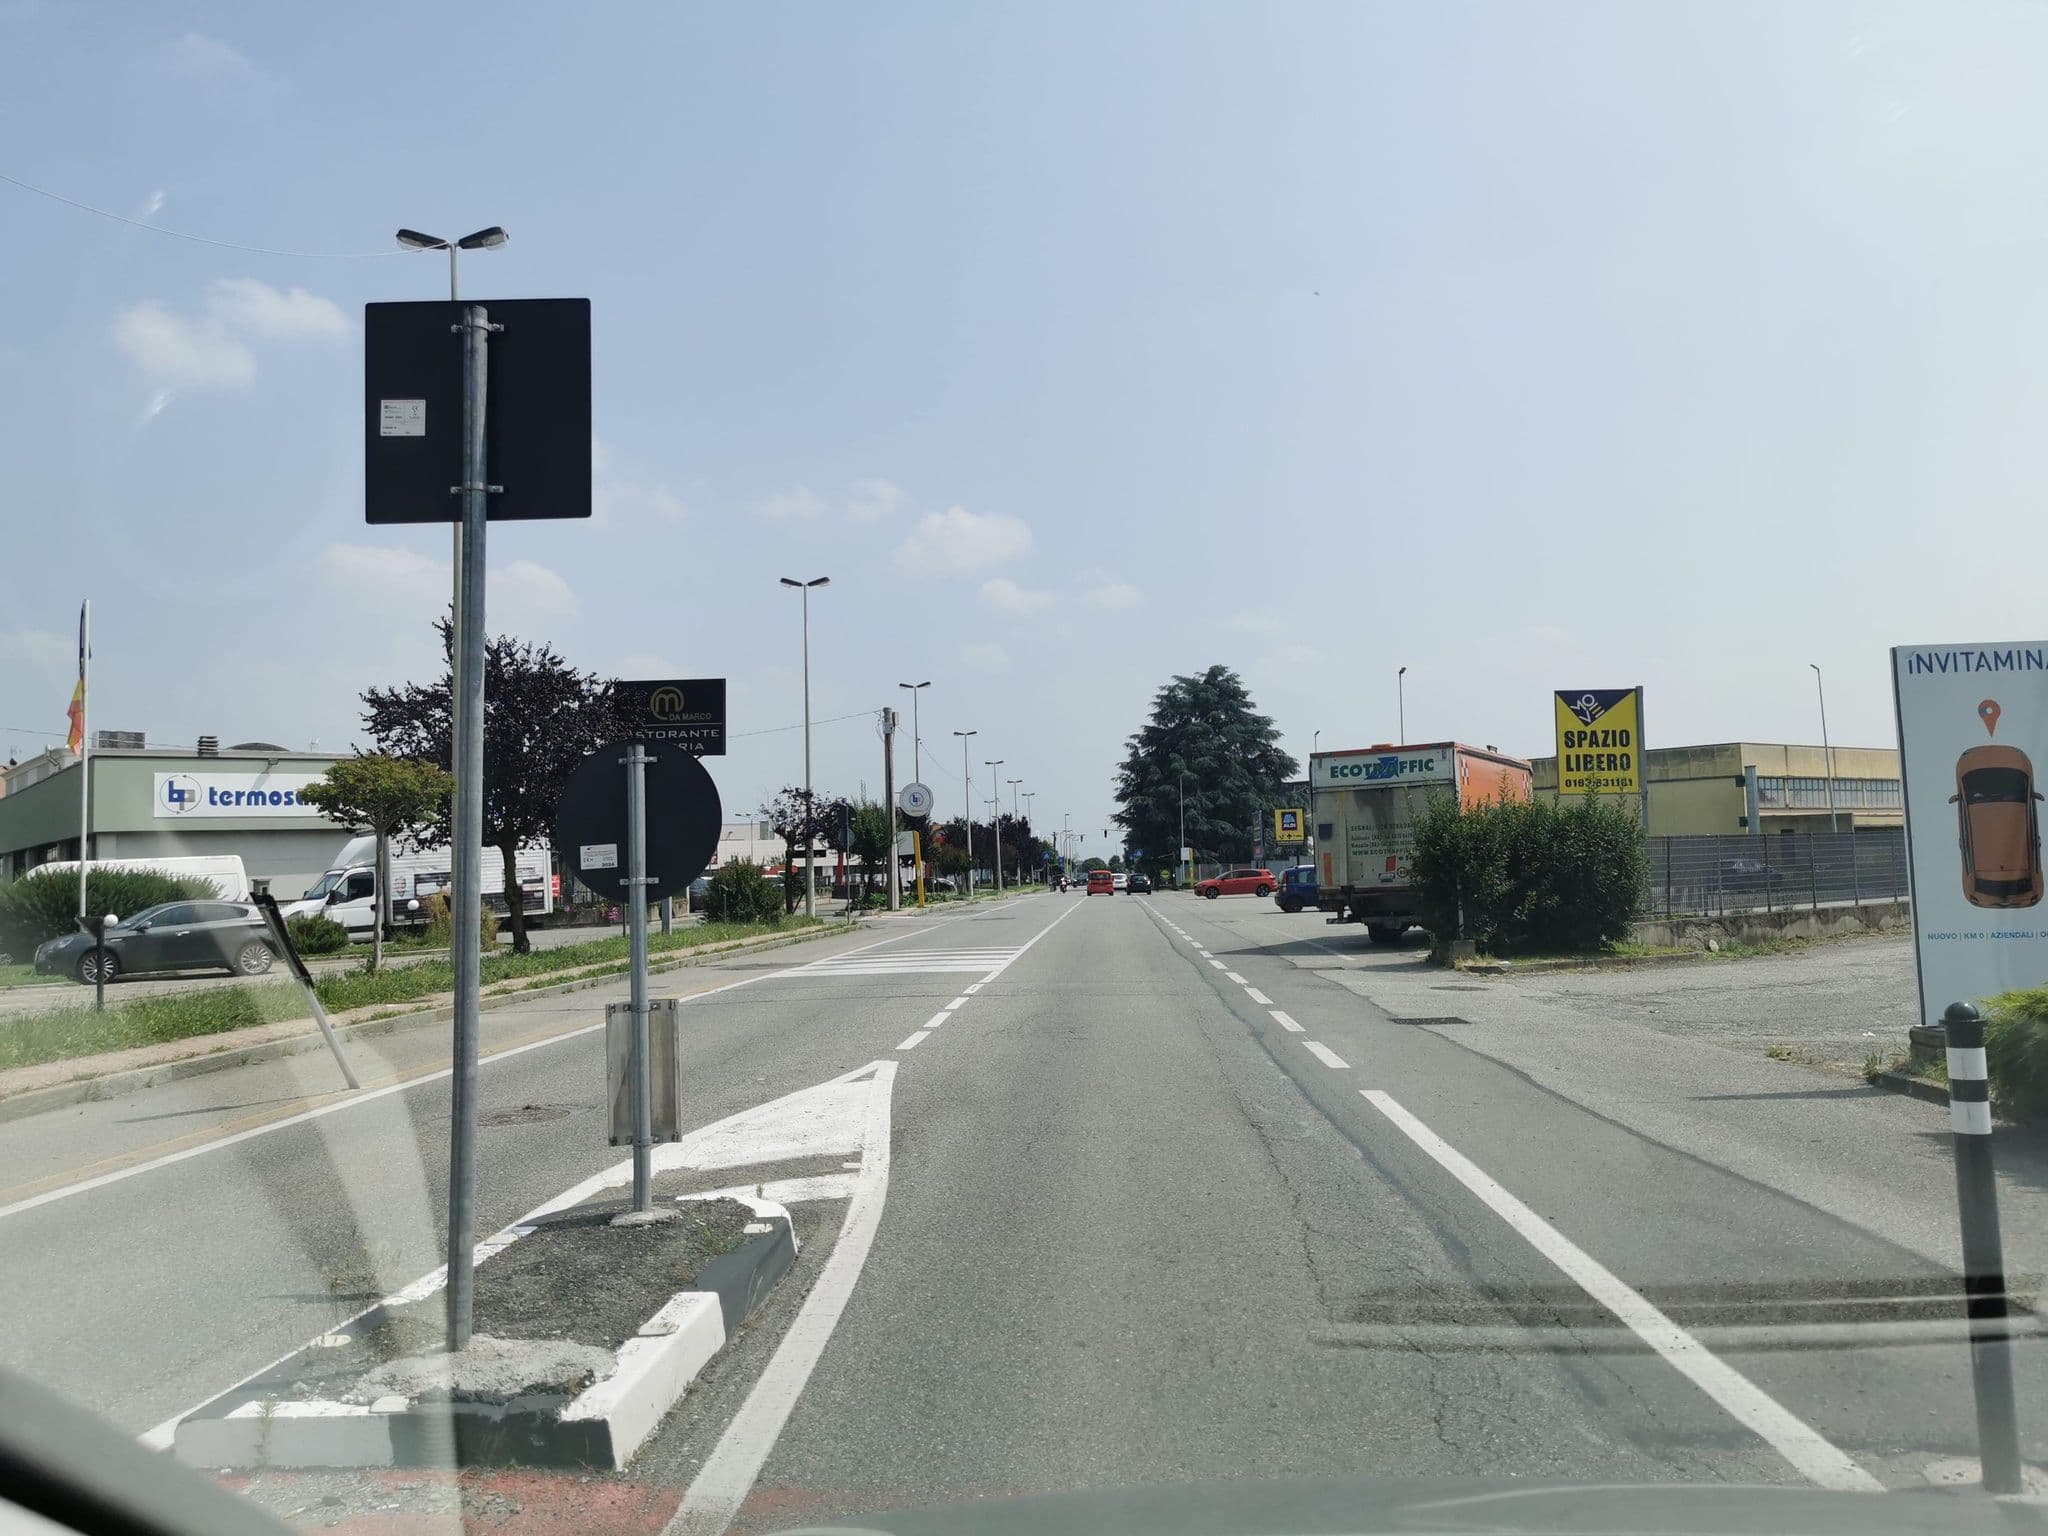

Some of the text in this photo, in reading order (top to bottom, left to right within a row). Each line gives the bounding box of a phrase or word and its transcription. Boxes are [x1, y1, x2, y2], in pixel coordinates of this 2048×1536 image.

[668, 712, 712, 721] DA MARCO
[633, 729, 720, 739] STORANTE
[1564, 729, 1630, 748] SPAZIO
[676, 742, 704, 751] RIA
[1565, 753, 1632, 772] LIBERO
[1330, 757, 1435, 780] ECOTRAFFIC
[1927, 932, 1957, 941] NUOVO
[1964, 932, 1977, 940] KM
[1990, 931, 2034, 939] AZIENDALI
